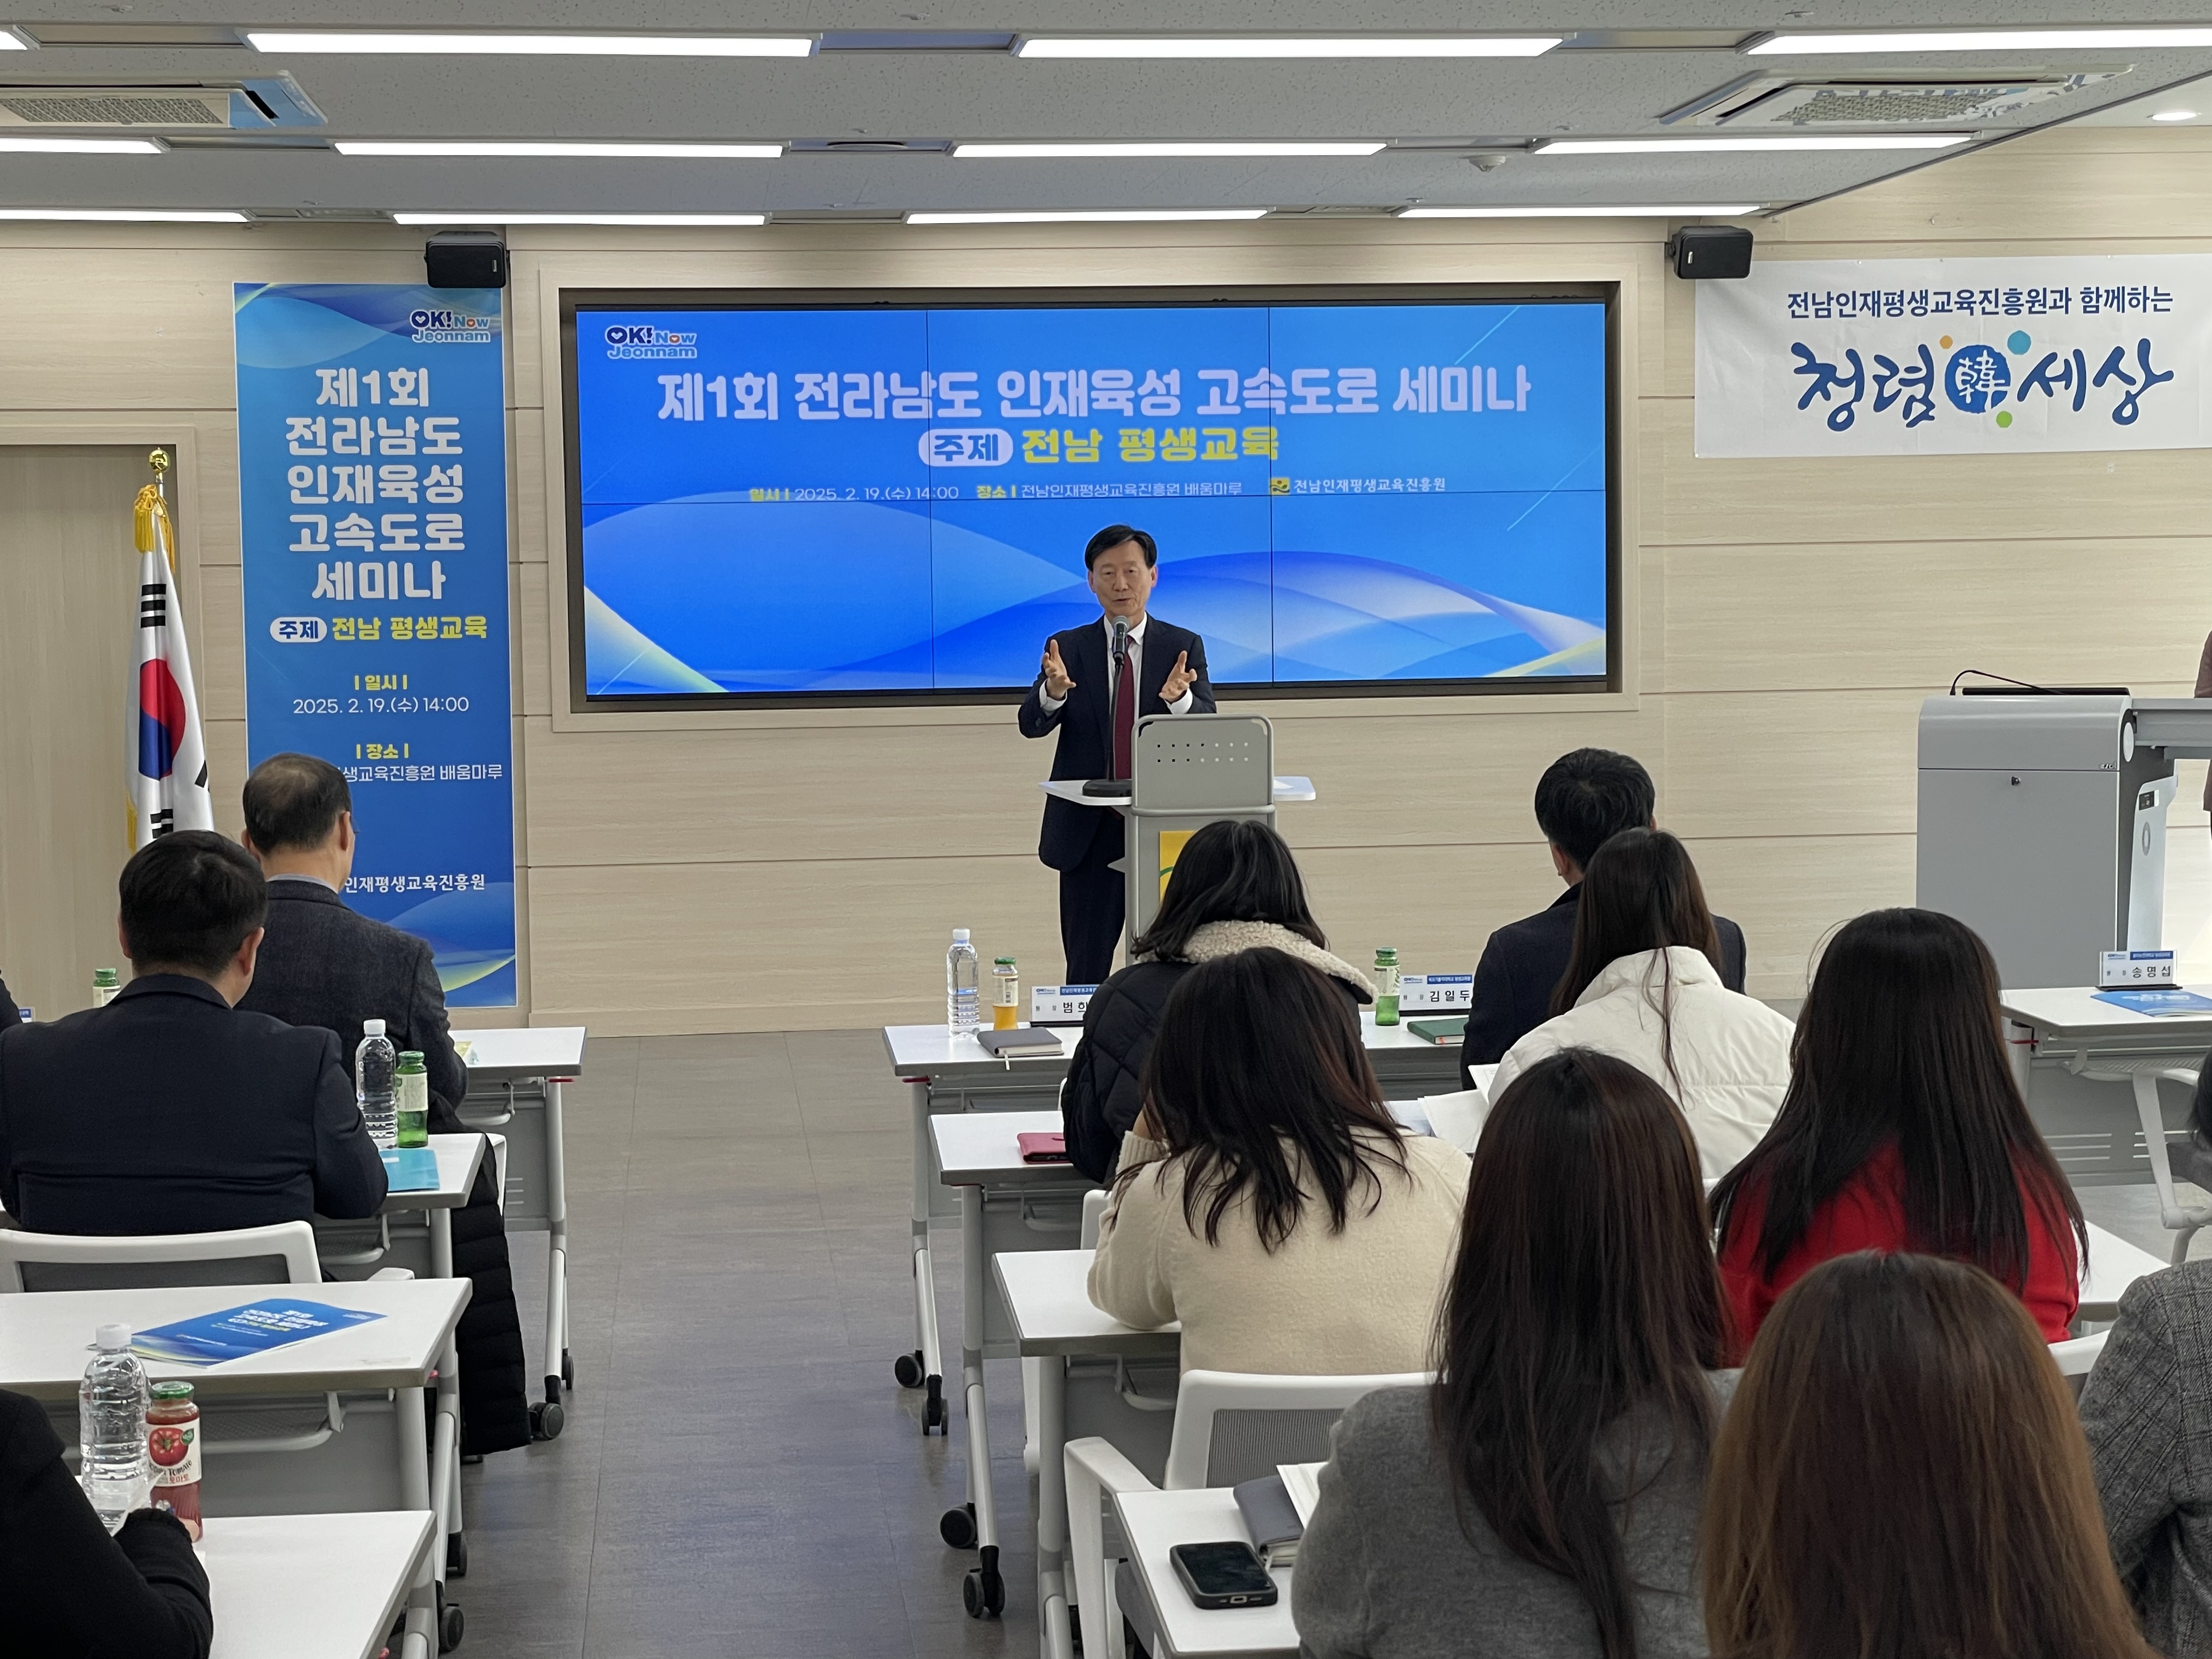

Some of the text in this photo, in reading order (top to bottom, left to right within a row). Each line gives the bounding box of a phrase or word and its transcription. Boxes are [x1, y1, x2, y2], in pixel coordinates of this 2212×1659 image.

[1787, 285, 2174, 319] 전남인재평생교육진흥원과 함께하는
[410, 310, 489, 329] OK! Now
[413, 330, 489, 342] Jeonnam
[606, 326, 696, 345] OK! Now
[608, 346, 696, 358] Jeonnam
[315, 367, 428, 407] 제1회
[658, 364, 1531, 422] 제1회 전라남도 인재육성 고속도로 세미나
[1791, 337, 2174, 432] 청렴 韓 세상
[285, 416, 462, 456] 전라남도
[934, 426, 1279, 463] 주제 전남 평생교육
[287, 464, 463, 504] 인재육성
[845, 488, 860, 500] 2.
[916, 486, 959, 500] 14:00
[977, 482, 1243, 499] 장소 전남인재평생교육진흥원 배움마루
[1294, 477, 1446, 493] 전남인재평생교육진흥원
[289, 512, 465, 552] 고속도로
[312, 560, 445, 600] 세미나
[279, 616, 487, 640] 주제 전남 평생교육
[365, 675, 397, 691] 일시
[293, 696, 469, 714] 2025. 2. 19.(수) 14:00
[366, 744, 398, 760] 장소
[338, 764, 503, 782] 생교육진흥원 배움마루
[345, 873, 485, 893] 인재평생교육진흥원
